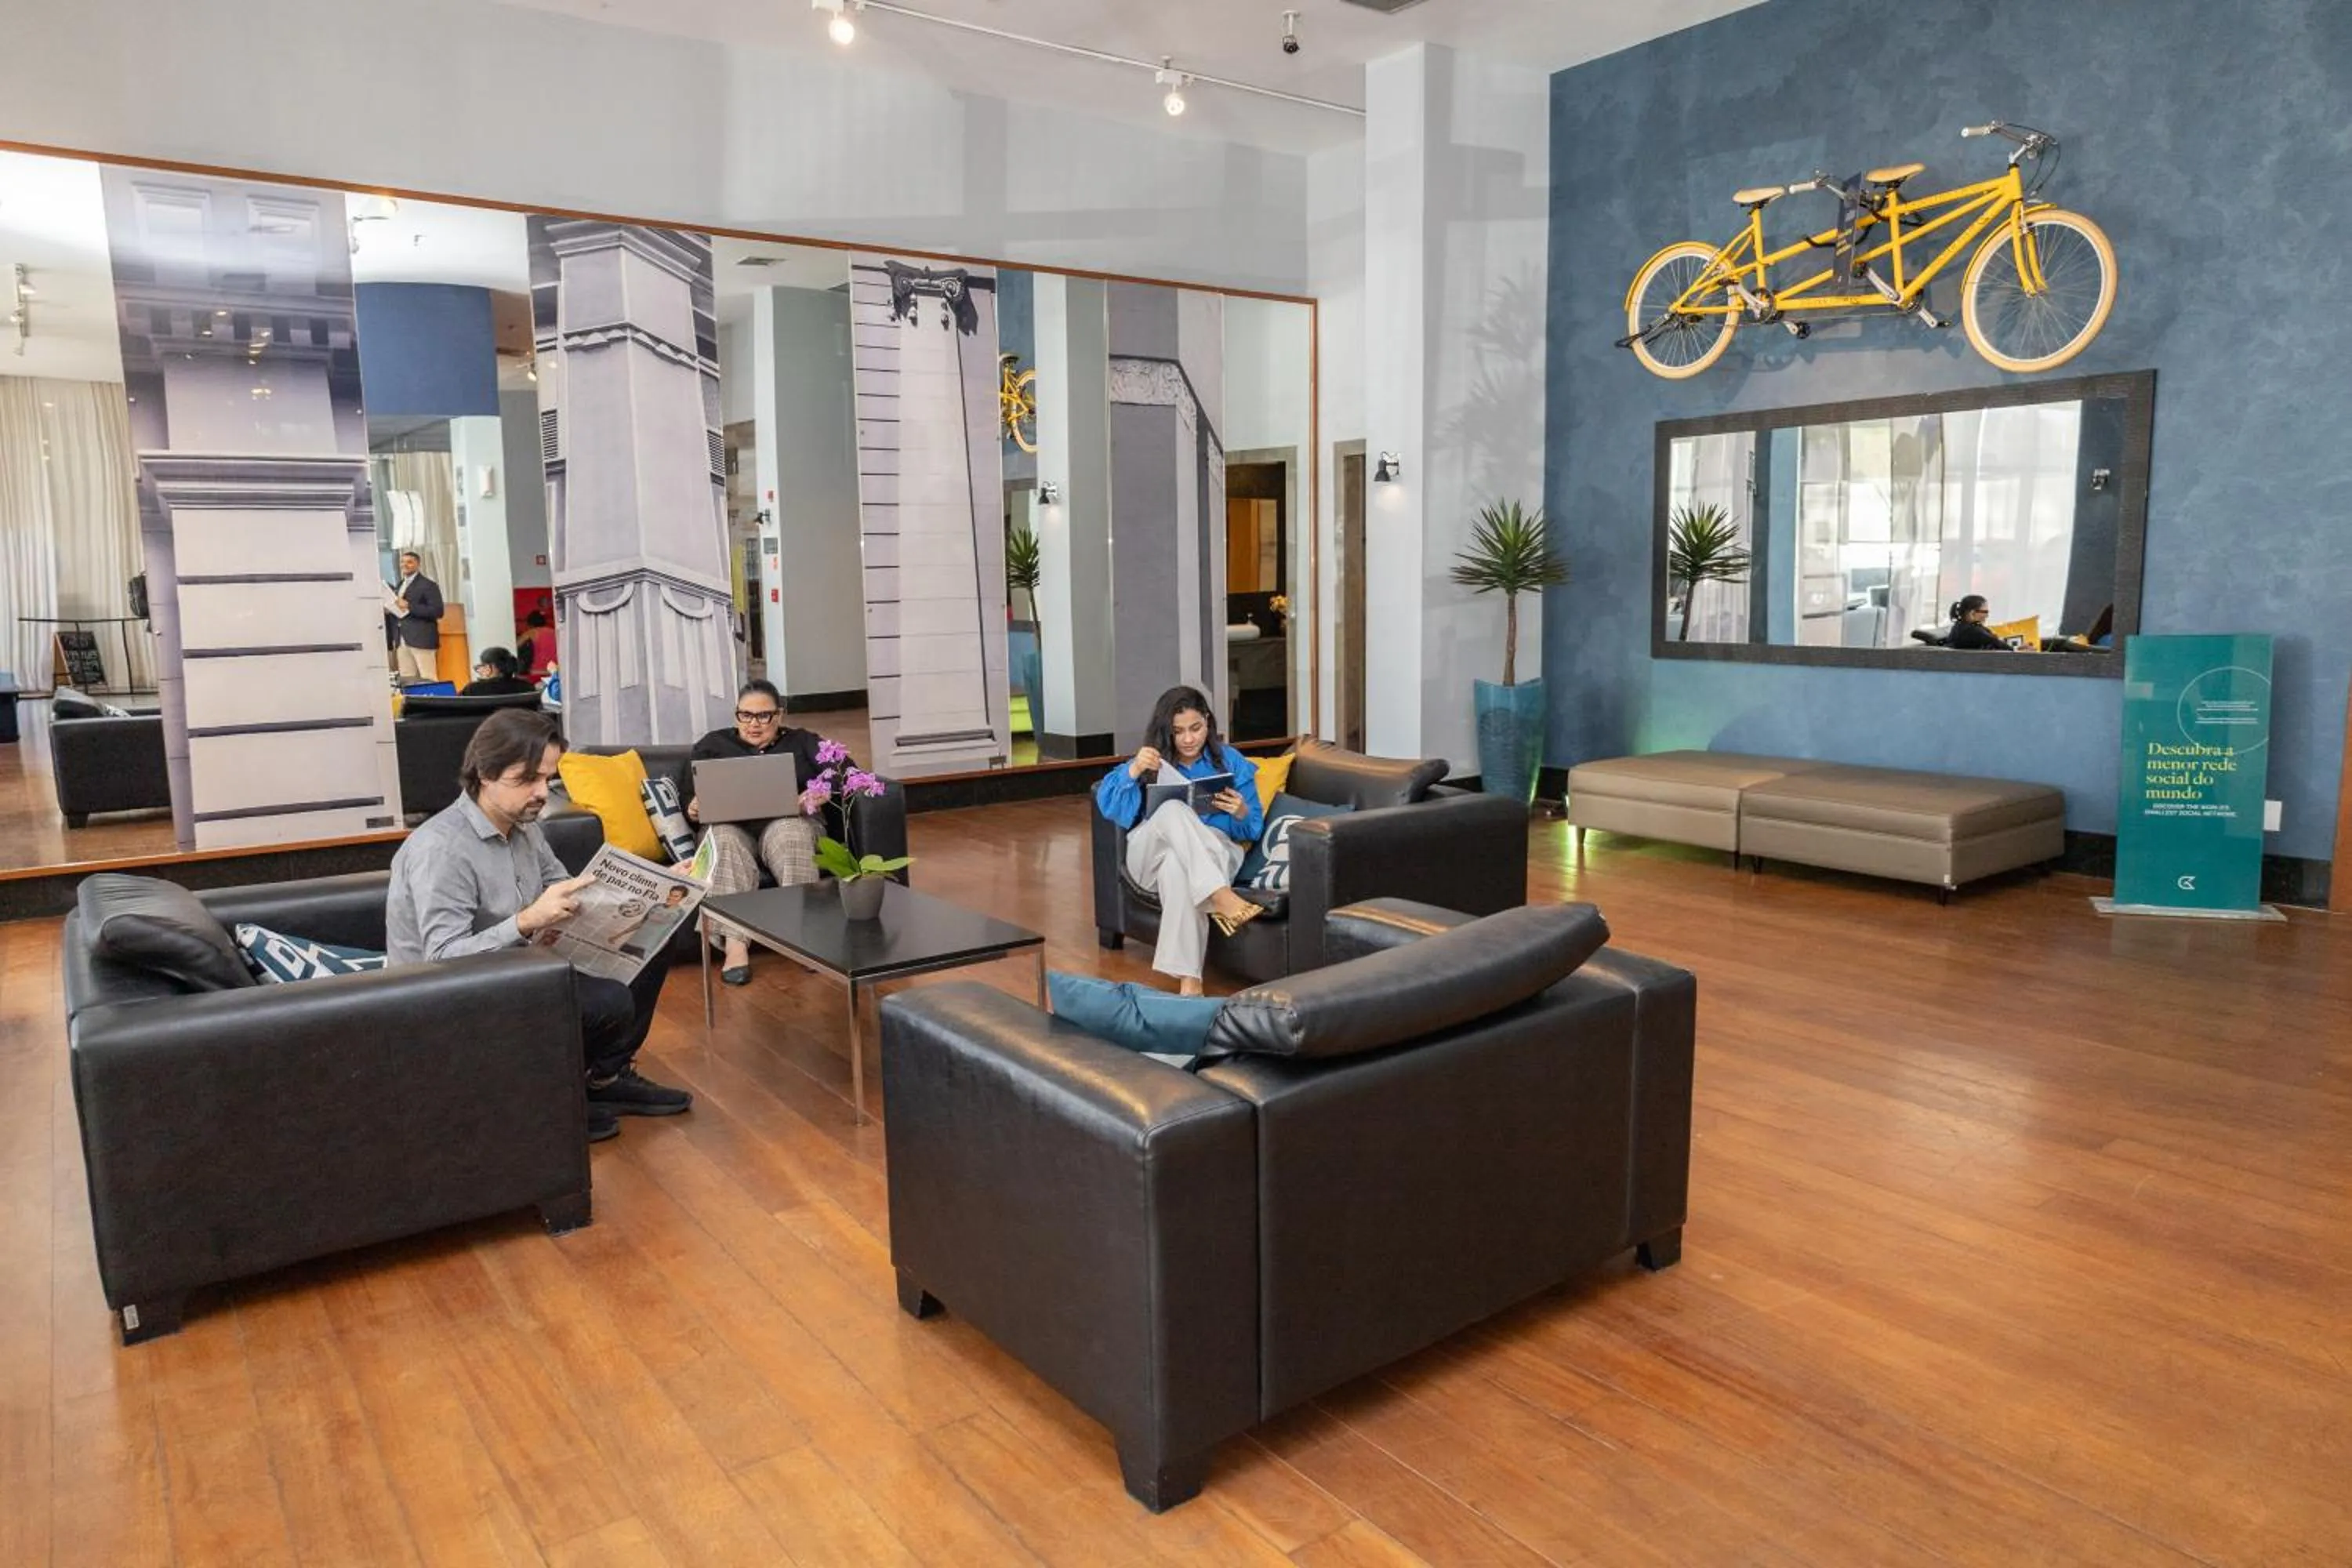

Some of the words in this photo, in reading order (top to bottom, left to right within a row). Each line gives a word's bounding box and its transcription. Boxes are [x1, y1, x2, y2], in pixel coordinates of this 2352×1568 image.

[2148, 742, 2222, 756] Descubra
[2224, 746, 2234, 757] a
[2147, 760, 2199, 771] menor
[2201, 757, 2238, 772] rede
[2146, 771, 2190, 785] social
[2192, 771, 2215, 785] do
[2145, 786, 2203, 799] mundo
[600, 858, 629, 877] Novo
[628, 873, 658, 890] clima
[593, 869, 608, 880] de
[605, 875, 629, 888] paz
[627, 884, 642, 895] no
[642, 888, 659, 902] Fla
